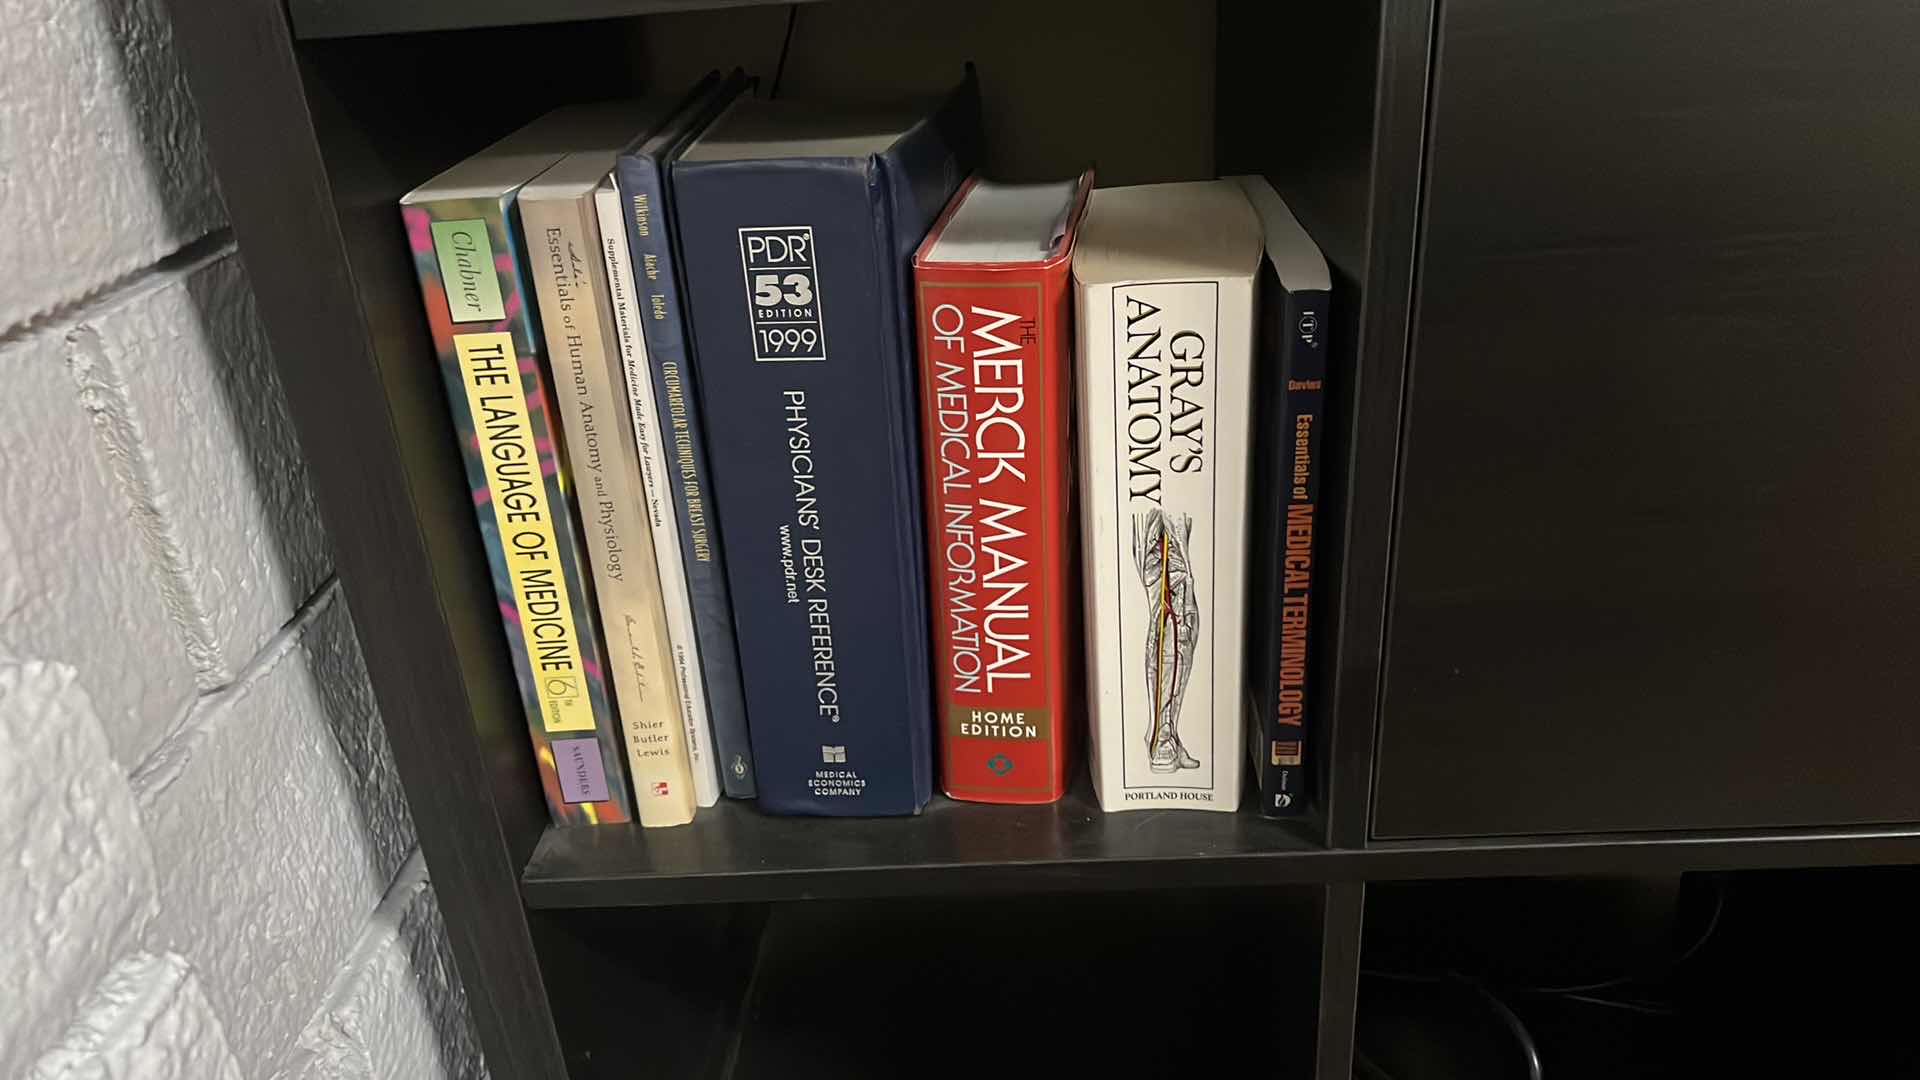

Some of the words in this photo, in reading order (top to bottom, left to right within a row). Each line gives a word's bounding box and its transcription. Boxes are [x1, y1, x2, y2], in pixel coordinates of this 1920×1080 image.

[451, 231, 482, 312] Chabner
[547, 228, 576, 312] Essentials
[755, 273, 813, 306] 53
[563, 315, 576, 331] of
[758, 308, 813, 318] EDITION
[932, 303, 965, 353] OF
[1019, 319, 1037, 345] THE
[758, 328, 817, 353] 1999
[468, 343, 510, 386] THE
[566, 335, 588, 396] Human
[607, 238, 625, 300] Supplemental
[618, 302, 632, 342] Materials
[627, 358, 639, 397] Medicine
[634, 398, 642, 422] Made
[638, 422, 646, 443] Easy
[642, 443, 650, 457] for
[651, 498, 661, 528] Nevada
[970, 305, 1027, 484] MERCK
[1126, 295, 1162, 506] ANATOMY
[1169, 329, 1206, 474] GRAY'S
[580, 401, 602, 477] Anatomy
[935, 361, 972, 494] MEDICAL
[1292, 414, 1313, 485] Essentials
[480, 396, 541, 524] LANGUAGE
[675, 430, 697, 480] TECHNIQUES
[594, 476, 607, 498] and
[684, 480, 700, 497] FOR
[1292, 486, 1309, 500] of
[686, 498, 706, 533] BREAST
[512, 531, 549, 561] OF
[598, 501, 624, 582] Physiology
[691, 532, 711, 562] SURGERY
[779, 524, 800, 603] www.pdr.net
[1282, 503, 1313, 593] MEDICAL
[801, 538, 826, 593] DESK
[944, 503, 982, 694] INFORMATION
[978, 498, 1032, 694] MANUAL
[520, 569, 573, 672] MEDICINE
[1278, 593, 1308, 727] TERMINOLOGY
[632, 721, 664, 731] Shier
[633, 734, 670, 744] Butler
[960, 723, 1037, 738] EDITION
[972, 711, 1025, 725] HOME
[637, 748, 670, 758] Lewis
[815, 771, 858, 779] MEDICAL
[808, 779, 866, 787] ECONOMICS
[814, 787, 862, 796] COMPANY
[1125, 791, 1178, 802] PORTLAND
[1180, 791, 1214, 802] HOUSE
